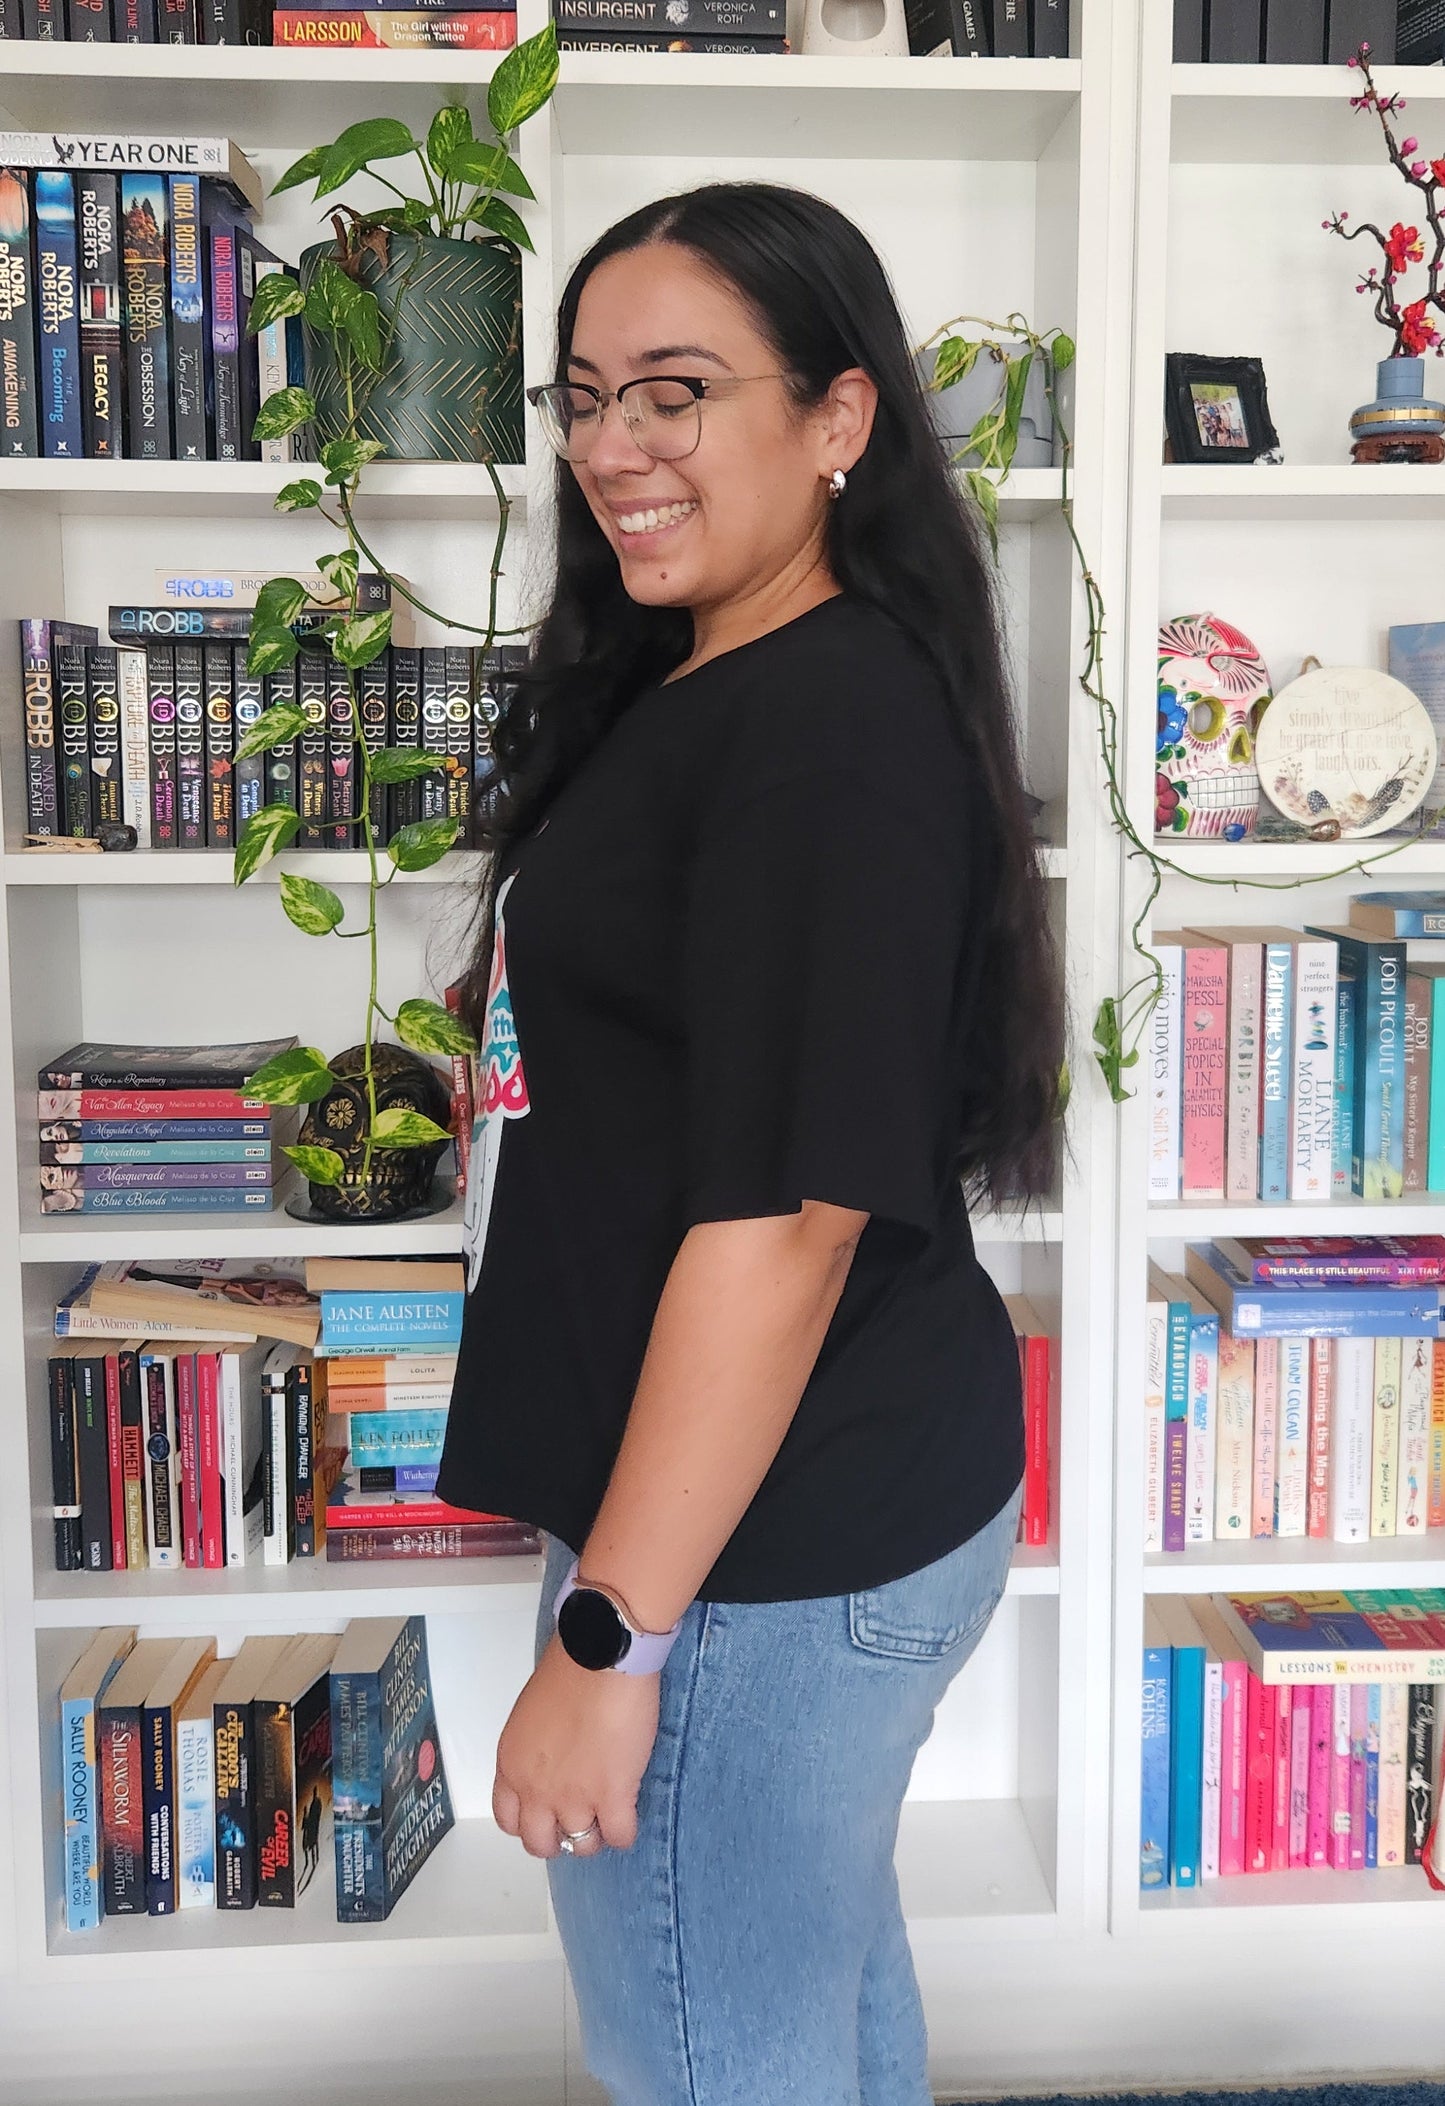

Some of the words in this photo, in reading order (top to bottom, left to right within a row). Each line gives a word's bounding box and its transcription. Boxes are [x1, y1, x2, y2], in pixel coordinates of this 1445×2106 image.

[559, 0, 657, 20] INSURGENT
[704, 1, 757, 14] VERONICA
[716, 14, 744, 25] ROTH
[962, 1, 977, 41] GAMES
[283, 20, 363, 42] LARSSON
[393, 31, 432, 43] Dragon
[434, 32, 466, 42] Tattoo
[77, 141, 144, 164] YEAR
[148, 144, 199, 165] ONE
[172, 183, 197, 226] NORA
[81, 190, 99, 270] ROBERTS
[96, 205, 113, 256] NORA
[174, 226, 198, 285] ROBERTS
[213, 236, 233, 274] NORA
[0, 242, 13, 321] ROBERTS
[10, 256, 27, 308] NORA
[41, 251, 60, 334] ROBERTS
[214, 272, 235, 322] ROBERTS
[2, 338, 21, 429] AWAKENING
[49, 347, 68, 424] Becoming
[92, 354, 110, 422] LEGACY
[138, 611, 205, 634] ROBB
[25, 658, 51, 672] J.D.
[60, 663, 86, 672] Roberts
[90, 664, 117, 672] Roberts
[94, 657, 112, 665] Nora
[24, 672, 55, 749] ROBB
[29, 755, 42, 770] IN
[30, 773, 44, 817] DEATH
[42, 763, 56, 812] NAKED
[155, 783, 163, 792] in
[164, 780, 175, 823] Ceremony
[182, 782, 191, 792] in
[190, 779, 202, 824] Vengeance
[314, 782, 325, 817] Witness
[342, 781, 353, 817] Betrayal
[433, 785, 446, 813] Purity
[459, 781, 471, 817] Divided
[155, 795, 166, 821] Death
[182, 795, 193, 820] Death
[1186, 975, 1224, 987] MARISHA
[1299, 984, 1334, 994] strangers
[1303, 972, 1331, 983] perfect
[1378, 955, 1399, 996] JODI
[1186, 991, 1225, 1006] PESSL
[1265, 950, 1291, 1042] Danielle
[1185, 1037, 1224, 1051] SPECIAL
[1236, 1008, 1255, 1094] MORBIDS
[1377, 1000, 1397, 1077] PICOULT
[1414, 1017, 1429, 1050] JODI
[90, 1073, 113, 1087] Keys
[123, 1073, 167, 1087] Repository
[454, 1062, 466, 1095] MATES
[1185, 1055, 1225, 1069] TOPICS
[1194, 1071, 1213, 1087] IN
[1263, 1044, 1284, 1102] Steel
[85, 1098, 106, 1111] Van
[133, 1099, 165, 1113] Legacy
[1183, 1087, 1224, 1101] CALAMITY
[1183, 1104, 1224, 1118] PHYSICS
[1296, 1059, 1313, 1172] MORIARTY
[1313, 1079, 1333, 1152] LIANE
[1342, 1111, 1352, 1150] LIANE
[94, 1143, 152, 1158] Revelations
[97, 1165, 167, 1188] Masquerade
[73, 1317, 98, 1329] Little
[100, 1318, 139, 1330] Women
[143, 1321, 172, 1331] Alcott
[328, 1305, 374, 1321] JANE
[380, 1304, 450, 1319] AUSTEN
[330, 1324, 350, 1333] THE
[354, 1322, 406, 1333] COMPLETE
[409, 1321, 450, 1331] NOVELS
[1171, 1325, 1187, 1401] EVANOVICH
[1287, 1344, 1303, 1385] JENNY
[1314, 1363, 1329, 1422] Burning
[228, 1401, 236, 1426] HOURS
[298, 1394, 310, 1434] RAYMOND
[1285, 1389, 1302, 1441] COLGAN
[124, 1429, 140, 1477] HAMMETT
[298, 1437, 311, 1479] CHANDLER
[1148, 1416, 1158, 1474] ELIZABETH
[1171, 1433, 1184, 1477] TWELVE
[1316, 1426, 1329, 1452] the
[154, 1463, 168, 1505] MICHAEL
[1313, 1454, 1329, 1488] Map
[230, 1467, 238, 1516] CUNNINGHAM
[295, 1495, 307, 1525] SLEEP
[304, 1488, 312, 1500] THE
[305, 1500, 314, 1517] BIG
[1147, 1477, 1158, 1522] GILBERT
[1170, 1480, 1183, 1517] SHARP
[156, 1507, 169, 1543] CHABON
[392, 1537, 403, 1551] WE
[433, 1530, 442, 1554] KEVIN
[115, 1540, 123, 1564] VINTAGE
[187, 1537, 195, 1561] VINTAGE
[208, 1538, 216, 1562] VINTAGE
[394, 1628, 411, 1667] BILL
[385, 1635, 422, 1707] CLINTON
[1279, 1662, 1332, 1673] LESSONS
[1350, 1661, 1416, 1673] CHEMISTRY
[391, 1673, 416, 1727] JAMES
[1141, 1679, 1157, 1740] JOHNS
[1156, 1678, 1168, 1737] RACHAEL
[71, 1717, 86, 1755] SALLY
[112, 1720, 128, 1731] THE
[154, 1716, 163, 1747] SALLY
[384, 1679, 429, 1770] PATTERSON
[183, 1727, 195, 1793] THOMAS
[196, 1736, 208, 1782] ROSIE
[216, 1727, 230, 1799] CALLING
[226, 1710, 240, 1789] CUCKOO'S
[112, 1732, 132, 1826] SILKWORM
[154, 1749, 164, 1792] ROONEY
[72, 1760, 88, 1825] ROONEY
[151, 1812, 160, 1837] WITH
[274, 1809, 289, 1868] CAREER
[386, 1774, 444, 1871] PRESIDENT'S
[151, 1837, 160, 1875] FRIENDS
[160, 1804, 170, 1881] CONVERSATIONS
[389, 1803, 445, 1892] DAUGHTER
[225, 1850, 233, 1897] GALBRAITH
[260, 1846, 276, 1881] EVIL
[342, 1832, 354, 1894] DAUGHTER
[353, 1829, 366, 1897] PRESIDENT'S
